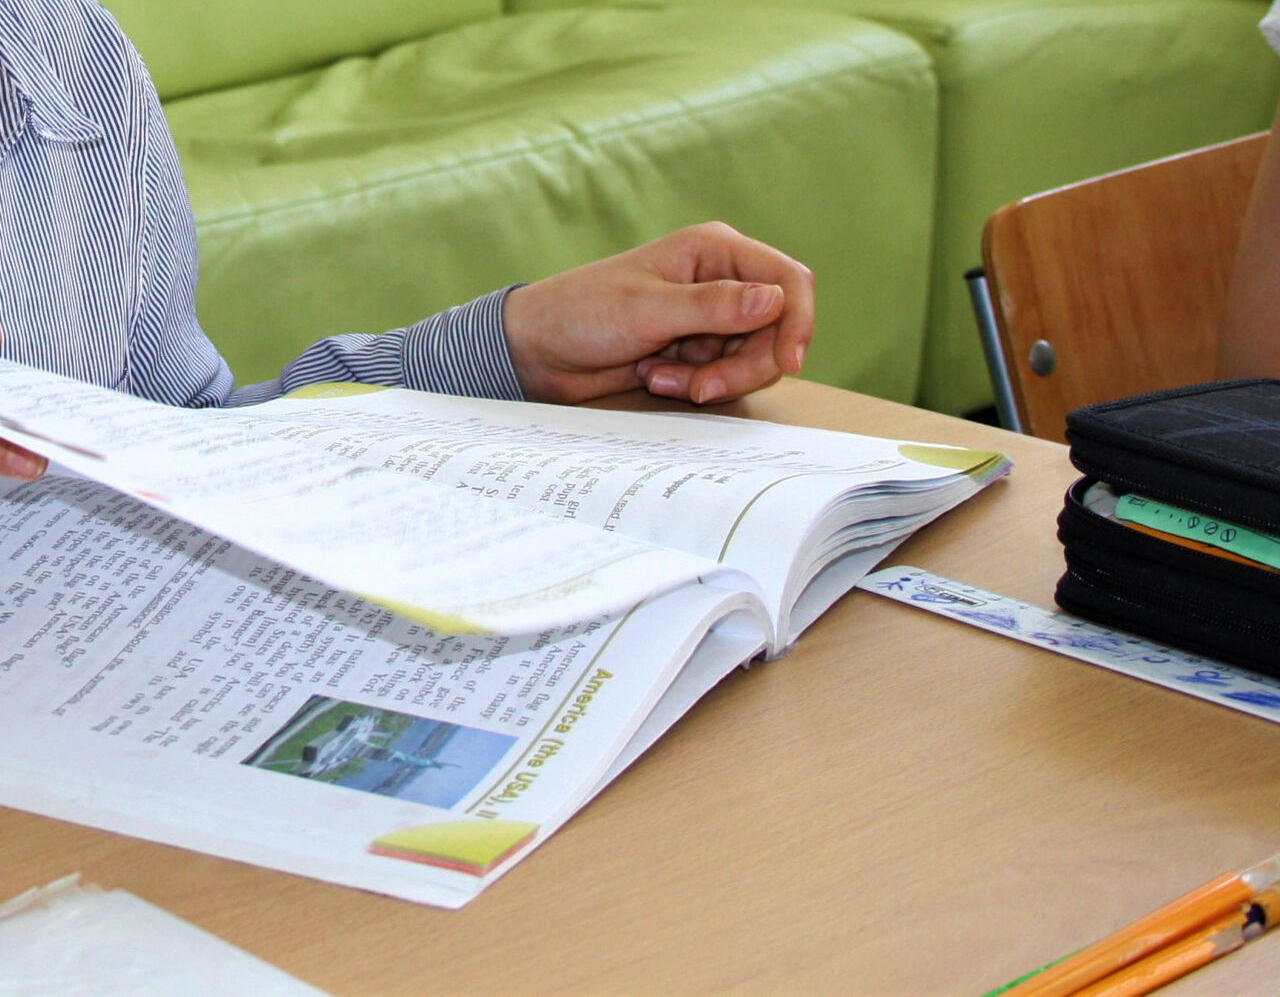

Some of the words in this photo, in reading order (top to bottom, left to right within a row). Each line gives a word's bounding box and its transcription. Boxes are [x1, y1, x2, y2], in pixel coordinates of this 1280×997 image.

[93, 517, 110, 526] 13
[8, 529, 48, 560] Свободы
[50, 529, 79, 550] know
[64, 528, 95, 552] stripes
[150, 528, 184, 554] colours
[161, 540, 188, 560] often
[21, 554, 50, 577] about
[49, 555, 66, 567] on
[58, 547, 93, 578] stripes?
[99, 549, 127, 570] there
[110, 556, 138, 577] there
[33, 570, 53, 584] the
[62, 572, 87, 588] flag
[143, 564, 164, 580] call
[3, 581, 24, 595] the
[126, 584, 146, 599] the
[223, 584, 247, 604] own
[260, 569, 297, 604] pangled
[11, 587, 37, 608] flag?
[43, 591, 66, 611] got?
[125, 586, 173, 629] questions?
[146, 579, 198, 625] information
[235, 591, 260, 612] state
[272, 586, 303, 612] hymn
[282, 592, 319, 624] United
[312, 589, 339, 610] back
[76, 590, 122, 630] American
[299, 614, 315, 627] of
[21, 609, 68, 648] American
[52, 614, 84, 639] USA?
[83, 603, 129, 643] American
[187, 611, 224, 644] symbol
[220, 618, 238, 629] in
[293, 613, 336, 654] strength).
[362, 610, 395, 642] official
[53, 635, 80, 655] flag?
[120, 629, 150, 653] about
[200, 635, 222, 650] the
[253, 628, 286, 656] States
[343, 633, 360, 642] It
[451, 641, 466, 652] as
[59, 647, 87, 668] flag?
[165, 650, 188, 669] and
[222, 651, 246, 667] too.
[263, 641, 293, 667] dollar
[301, 635, 336, 668] symbol
[324, 648, 347, 665] has
[384, 642, 411, 665] New
[403, 643, 428, 663] first
[473, 636, 511, 674] symbols
[173, 657, 203, 678] USA
[239, 661, 255, 673] of
[273, 661, 298, 678] You
[325, 648, 365, 687] national
[407, 662, 436, 683] York
[448, 647, 485, 681] France
[515, 645, 564, 698] Americans
[518, 659, 533, 668] it
[543, 640, 587, 687] American
[210, 674, 226, 683] It
[289, 671, 305, 683] of
[359, 673, 387, 693] York
[375, 669, 407, 697] things
[461, 679, 477, 692] of
[505, 674, 520, 685] in
[199, 676, 241, 713] America
[254, 682, 275, 698] can
[259, 684, 292, 713] peace)
[392, 688, 410, 701] on
[409, 671, 444, 705] symbol
[427, 686, 451, 708] gave
[169, 698, 200, 722] called
[445, 696, 466, 712] the
[478, 692, 508, 719] many
[524, 692, 551, 711] flag
[552, 668, 613, 733] America
[497, 706, 517, 723] are
[515, 715, 533, 727] in
[525, 737, 565, 768] (the
[484, 767, 538, 806] USA),
